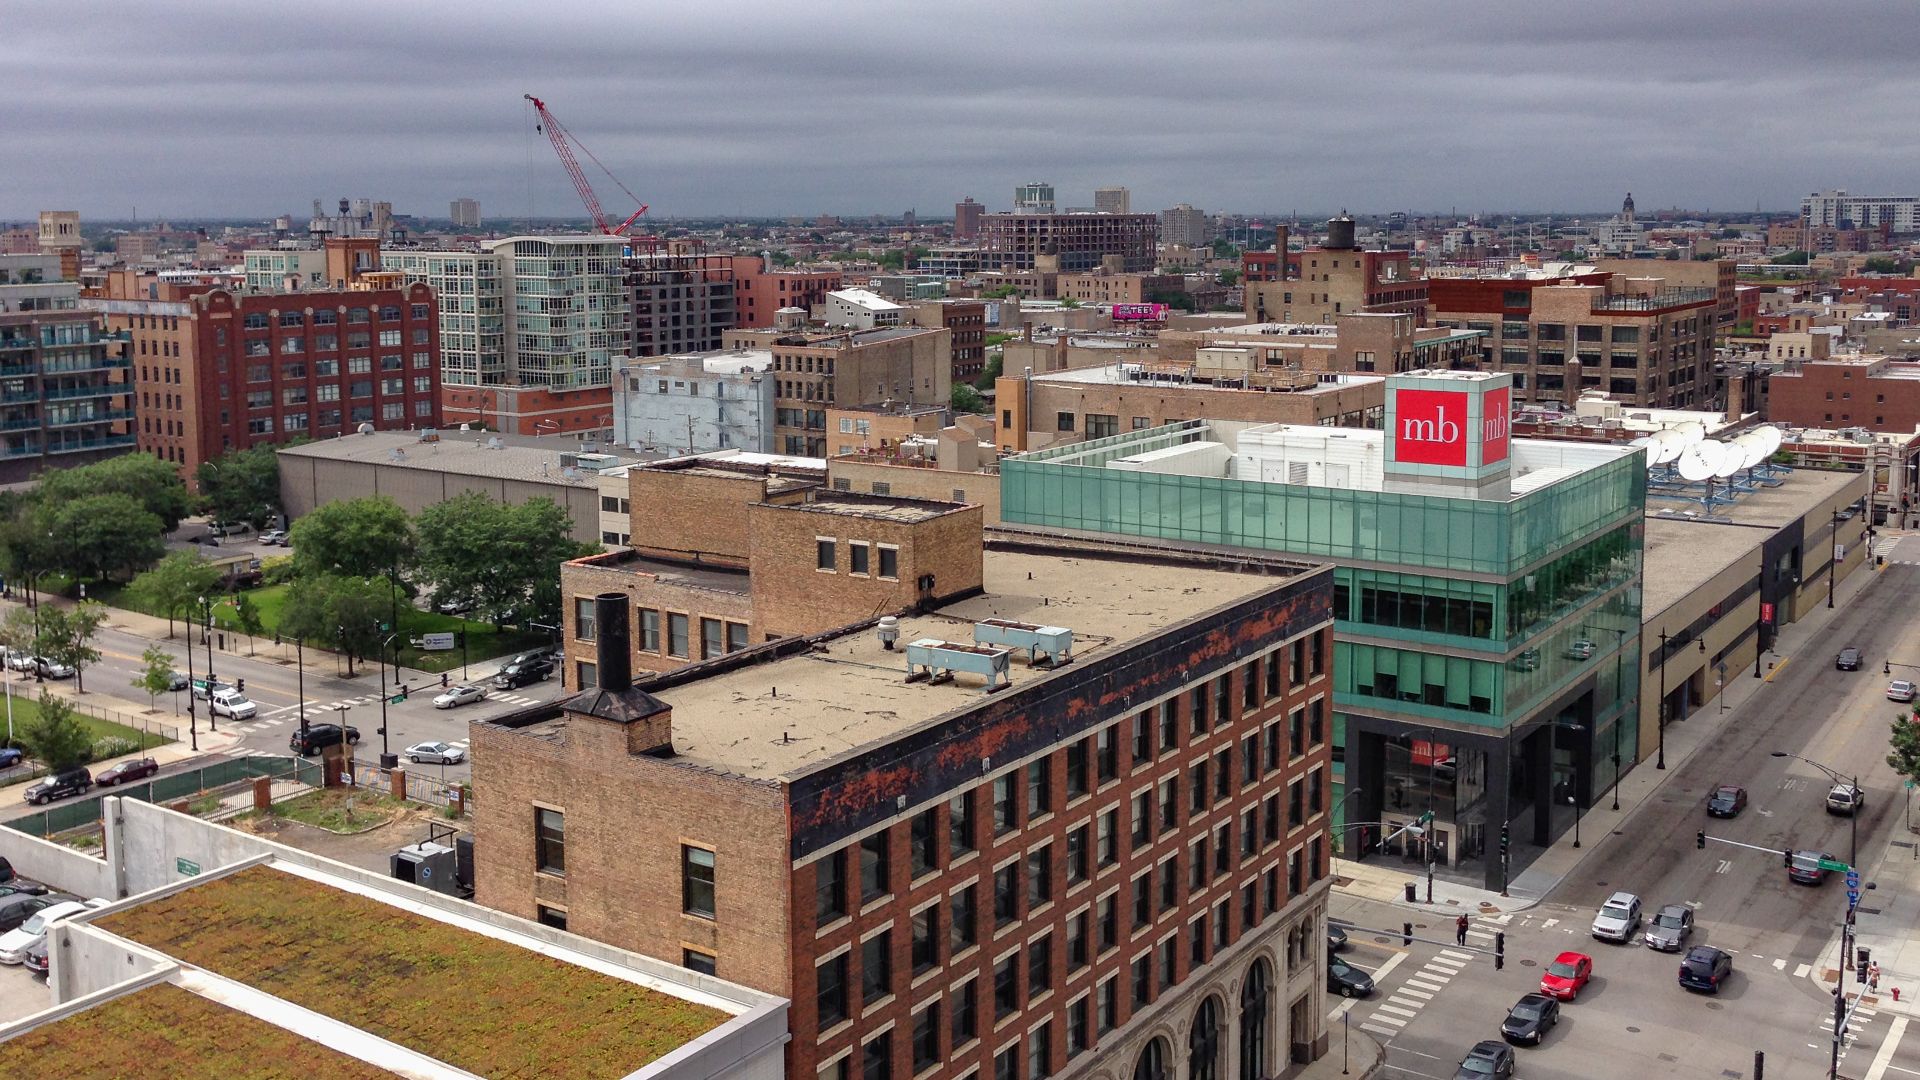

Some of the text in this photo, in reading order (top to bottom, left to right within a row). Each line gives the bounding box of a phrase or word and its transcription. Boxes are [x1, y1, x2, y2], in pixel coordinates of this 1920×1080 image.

[1130, 306, 1154, 314] TEES
[1403, 405, 1459, 443] mb
[1486, 403, 1506, 442] mb
